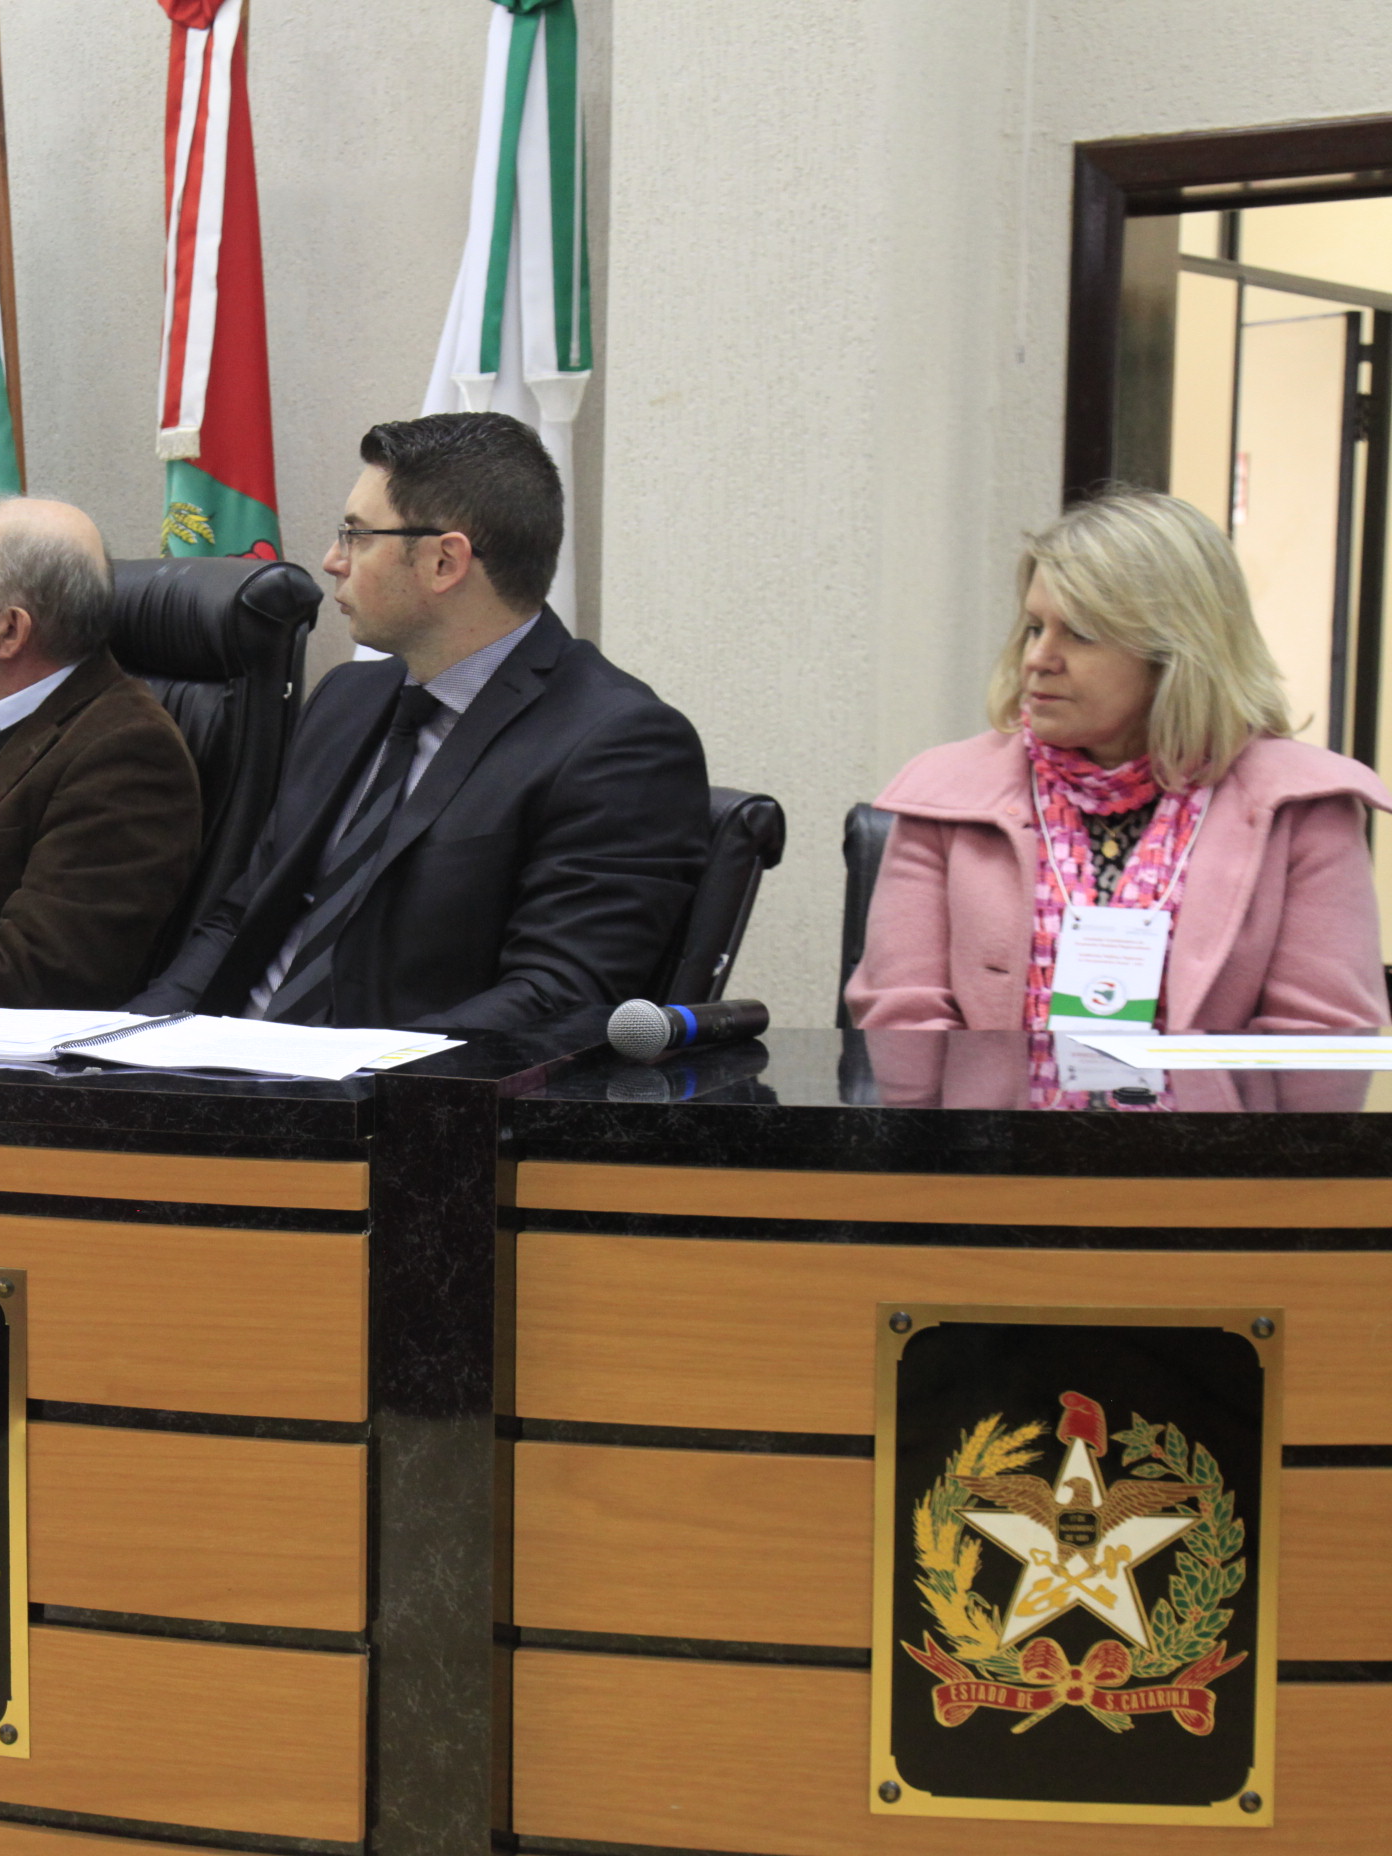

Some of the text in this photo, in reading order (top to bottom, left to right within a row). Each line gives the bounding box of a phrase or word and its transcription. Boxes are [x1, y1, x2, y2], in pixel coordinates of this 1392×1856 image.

[950, 1683, 1007, 1704] ESTADO
[1016, 1691, 1034, 1709] DE
[1120, 1689, 1190, 1711] CATARINA
